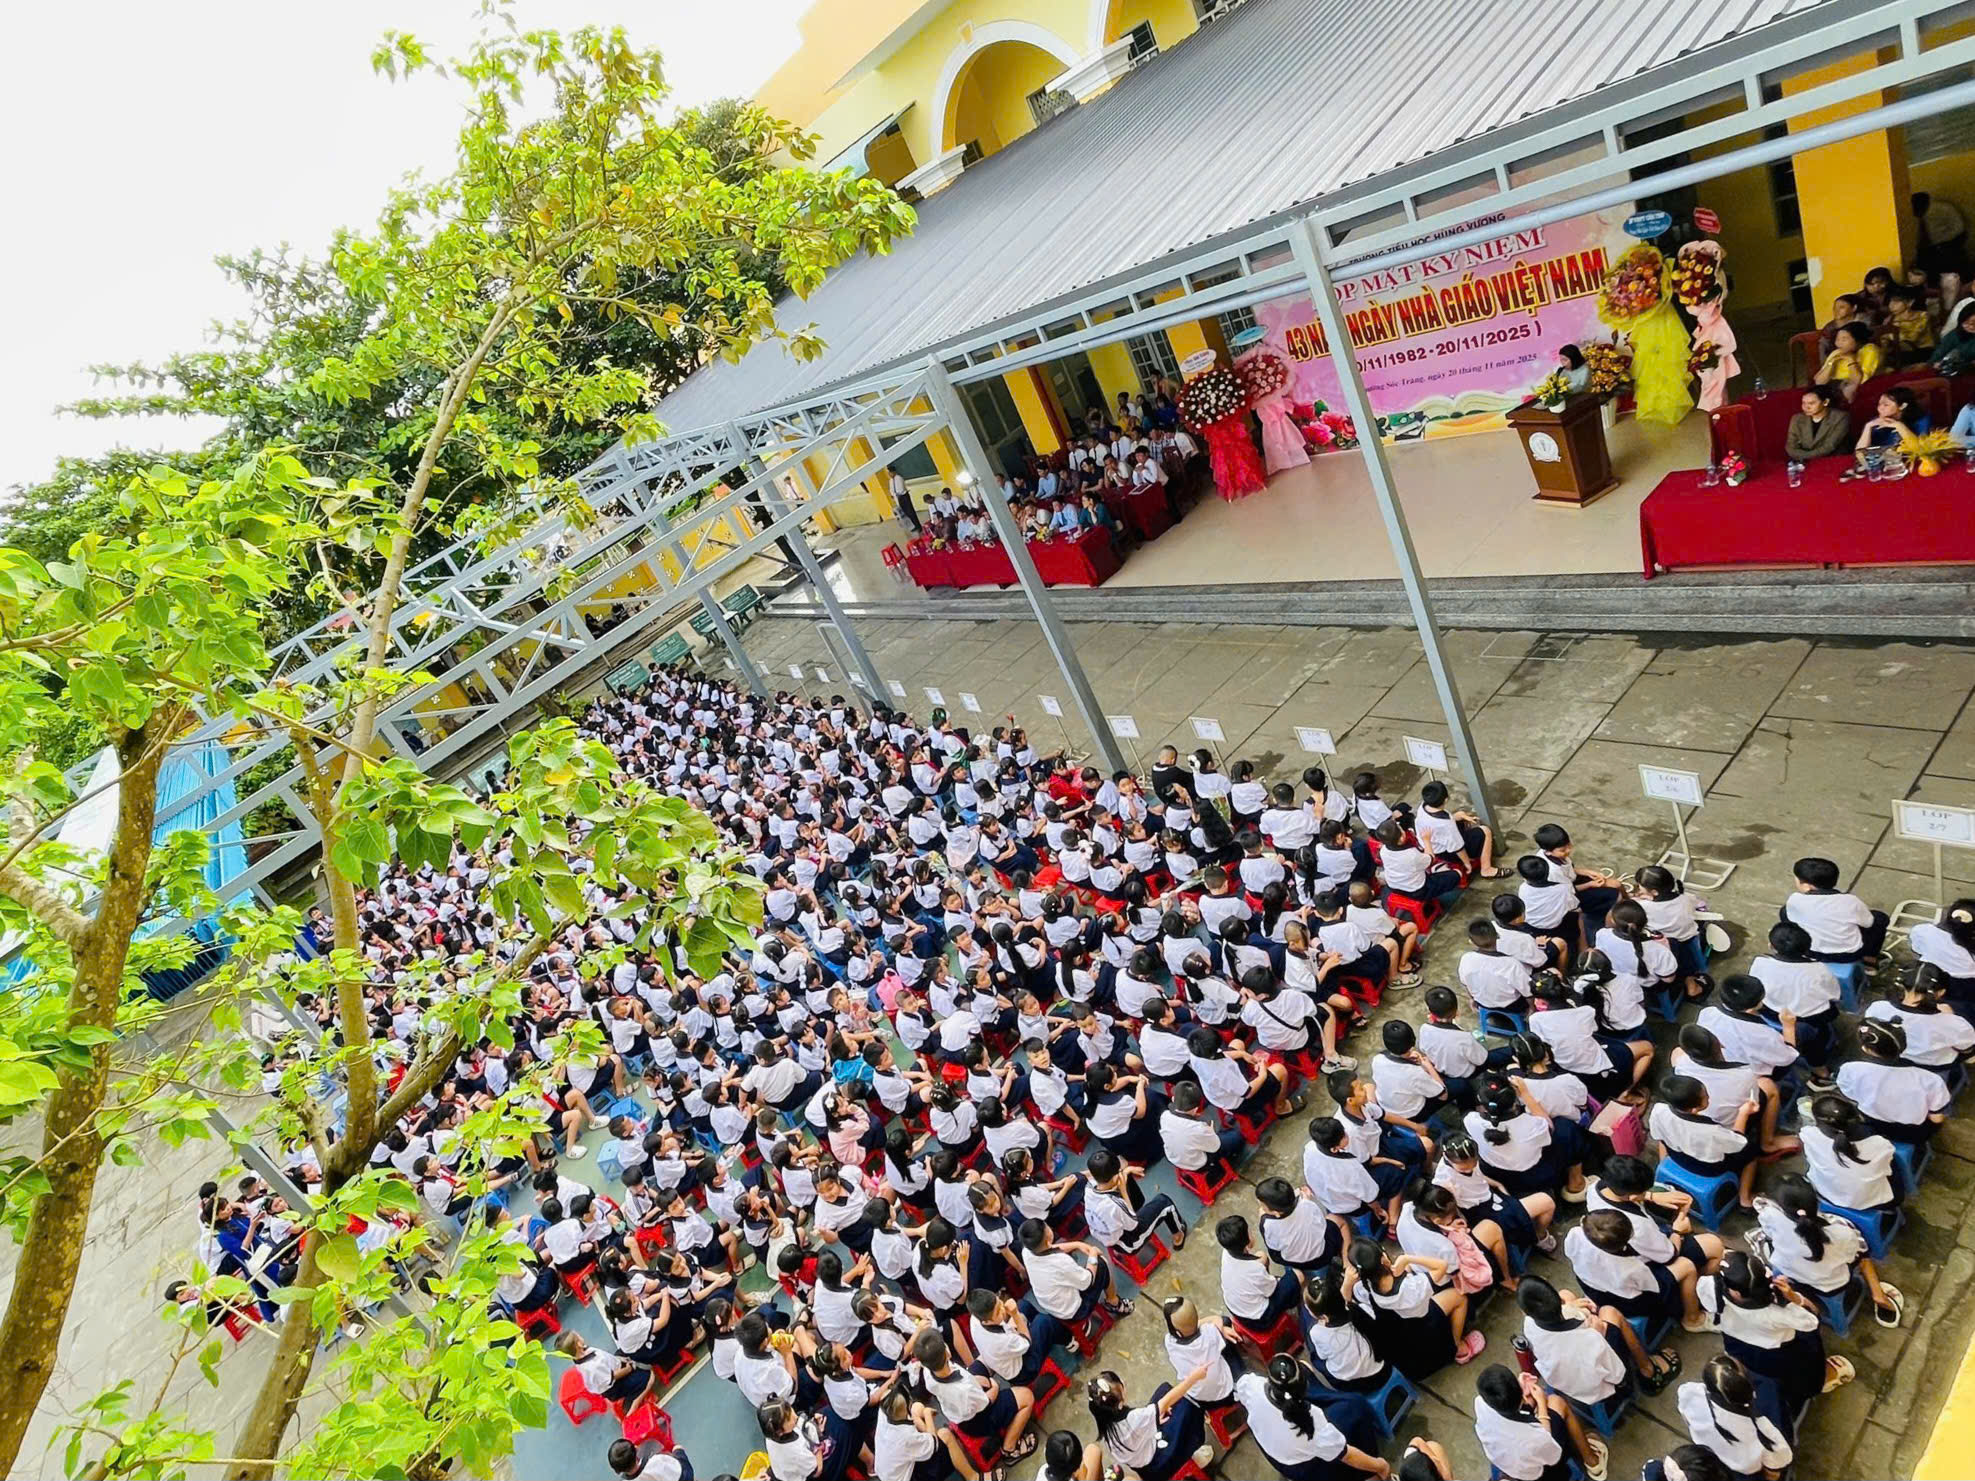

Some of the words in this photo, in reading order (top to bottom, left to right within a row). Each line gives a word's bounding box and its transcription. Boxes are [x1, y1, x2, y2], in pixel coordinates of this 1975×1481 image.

[1361, 264, 1413, 294] MẶT
[1285, 326, 1311, 361] 43
[1345, 300, 1398, 348] NGÀY
[1397, 285, 1443, 335] NHÀ
[1439, 272, 1495, 325] GIÁO
[1491, 259, 1547, 315] VIỆT
[1548, 248, 1606, 300] NAM
[1435, 323, 1532, 357] 20/11/2025
[1516, 352, 1537, 364] 2025
